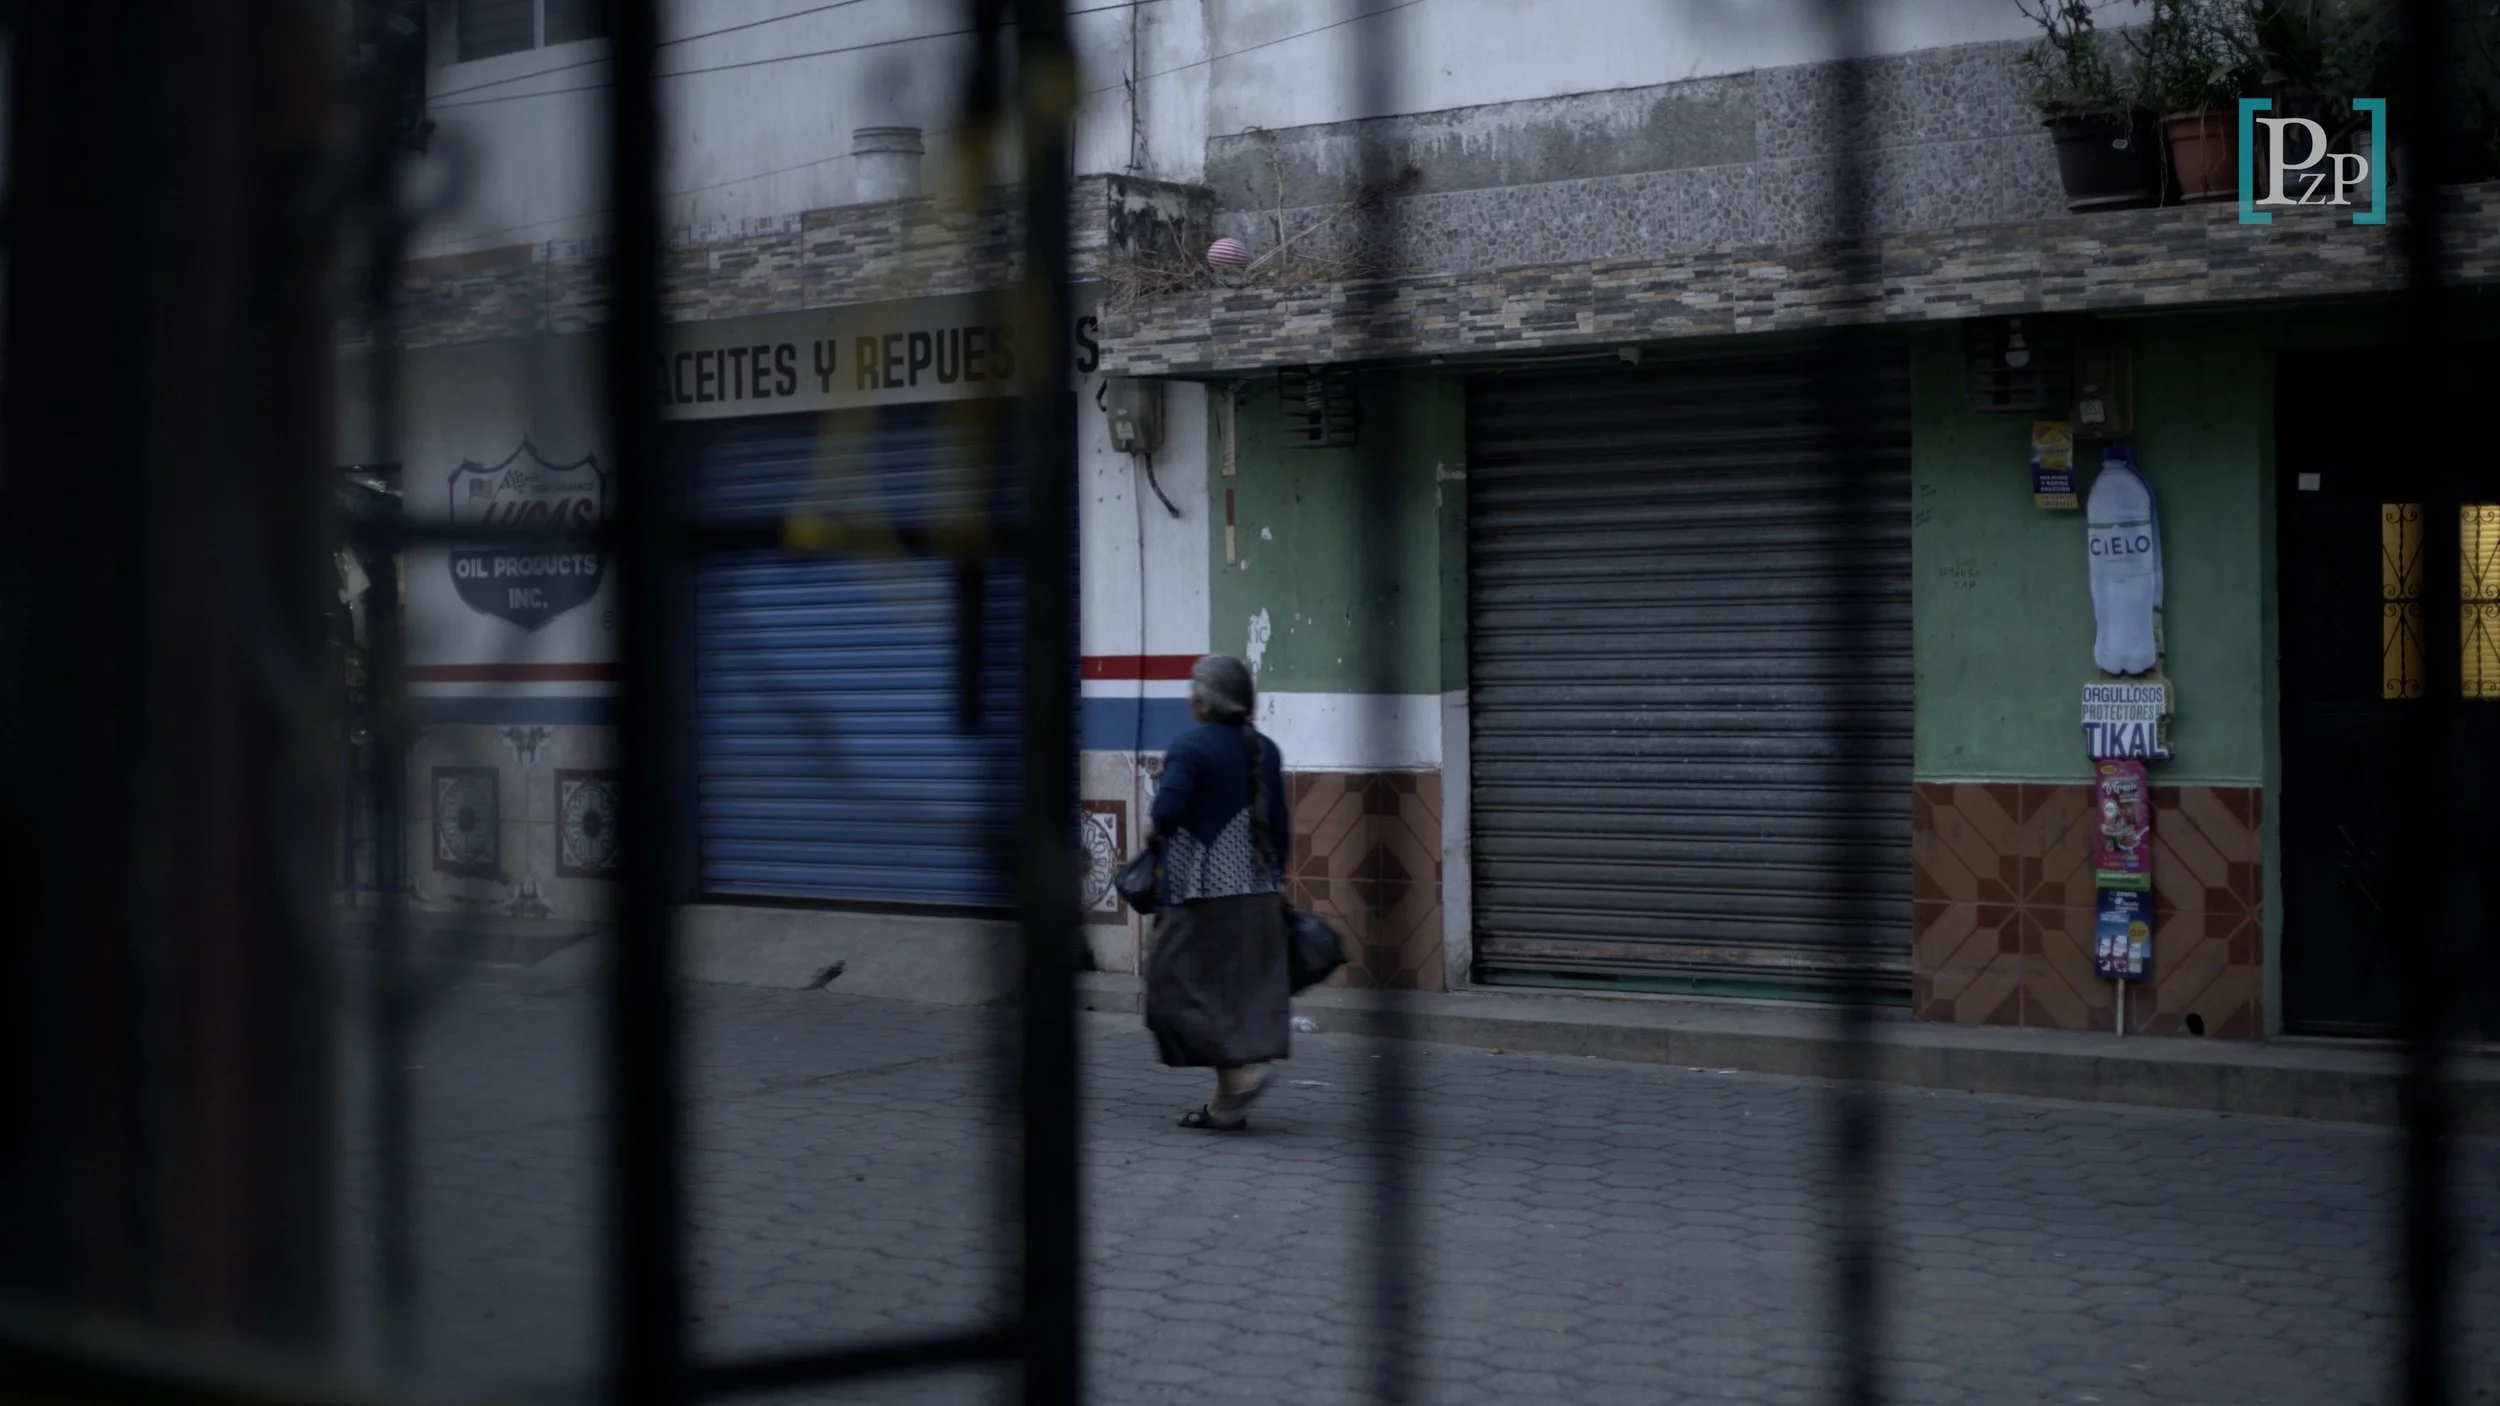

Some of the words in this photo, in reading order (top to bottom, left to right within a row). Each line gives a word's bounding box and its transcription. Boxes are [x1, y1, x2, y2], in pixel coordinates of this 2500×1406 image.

[814, 339, 836, 393] Y
[855, 316, 1099, 391] REPUESS
[2090, 535, 2151, 556] CIELO
[456, 557, 489, 579] OIL
[493, 553, 598, 577] PRODUCTS
[508, 587, 549, 609] INC.
[2083, 687, 2163, 703] ORGULLOSOS
[2082, 704, 2154, 720] PROTECTORES
[2083, 722, 2166, 758] TIKAL
